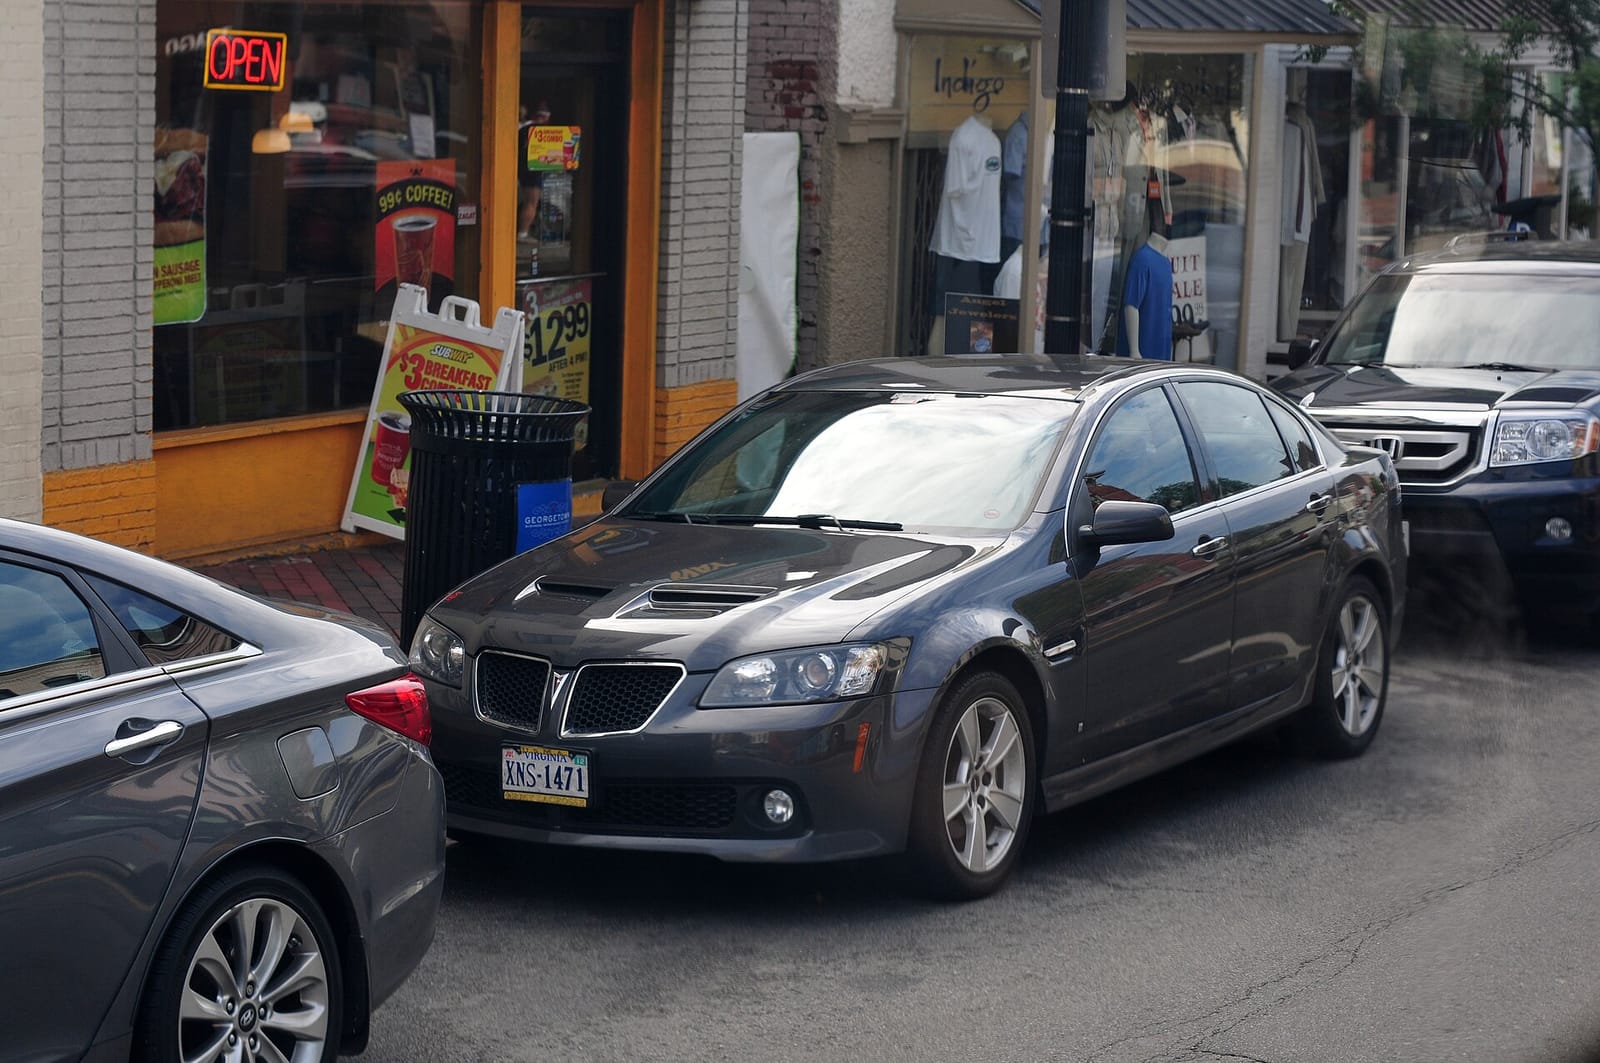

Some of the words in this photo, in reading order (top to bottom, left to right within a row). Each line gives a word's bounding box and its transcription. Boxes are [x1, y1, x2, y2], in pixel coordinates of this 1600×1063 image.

[209, 35, 282, 83] OPEN
[933, 57, 1005, 113] Indigo
[543, 135, 563, 143] COMBO
[379, 189, 402, 213] 99¢
[405, 184, 454, 209] COFFEE!
[160, 259, 201, 277] SAUSAGE
[1170, 252, 1200, 274] UIT
[1172, 280, 1203, 299] ALE
[526, 290, 539, 320] 3
[430, 344, 474, 364] SUBWAY
[548, 359, 568, 373] AFTER
[569, 356, 574, 366] 4
[400, 351, 426, 390] $3
[424, 360, 492, 391] BREAKFAST
[524, 512, 570, 525] GEORGETOWN
[523, 750, 568, 763] VIRGINIA
[505, 759, 585, 792] XNS-1471
